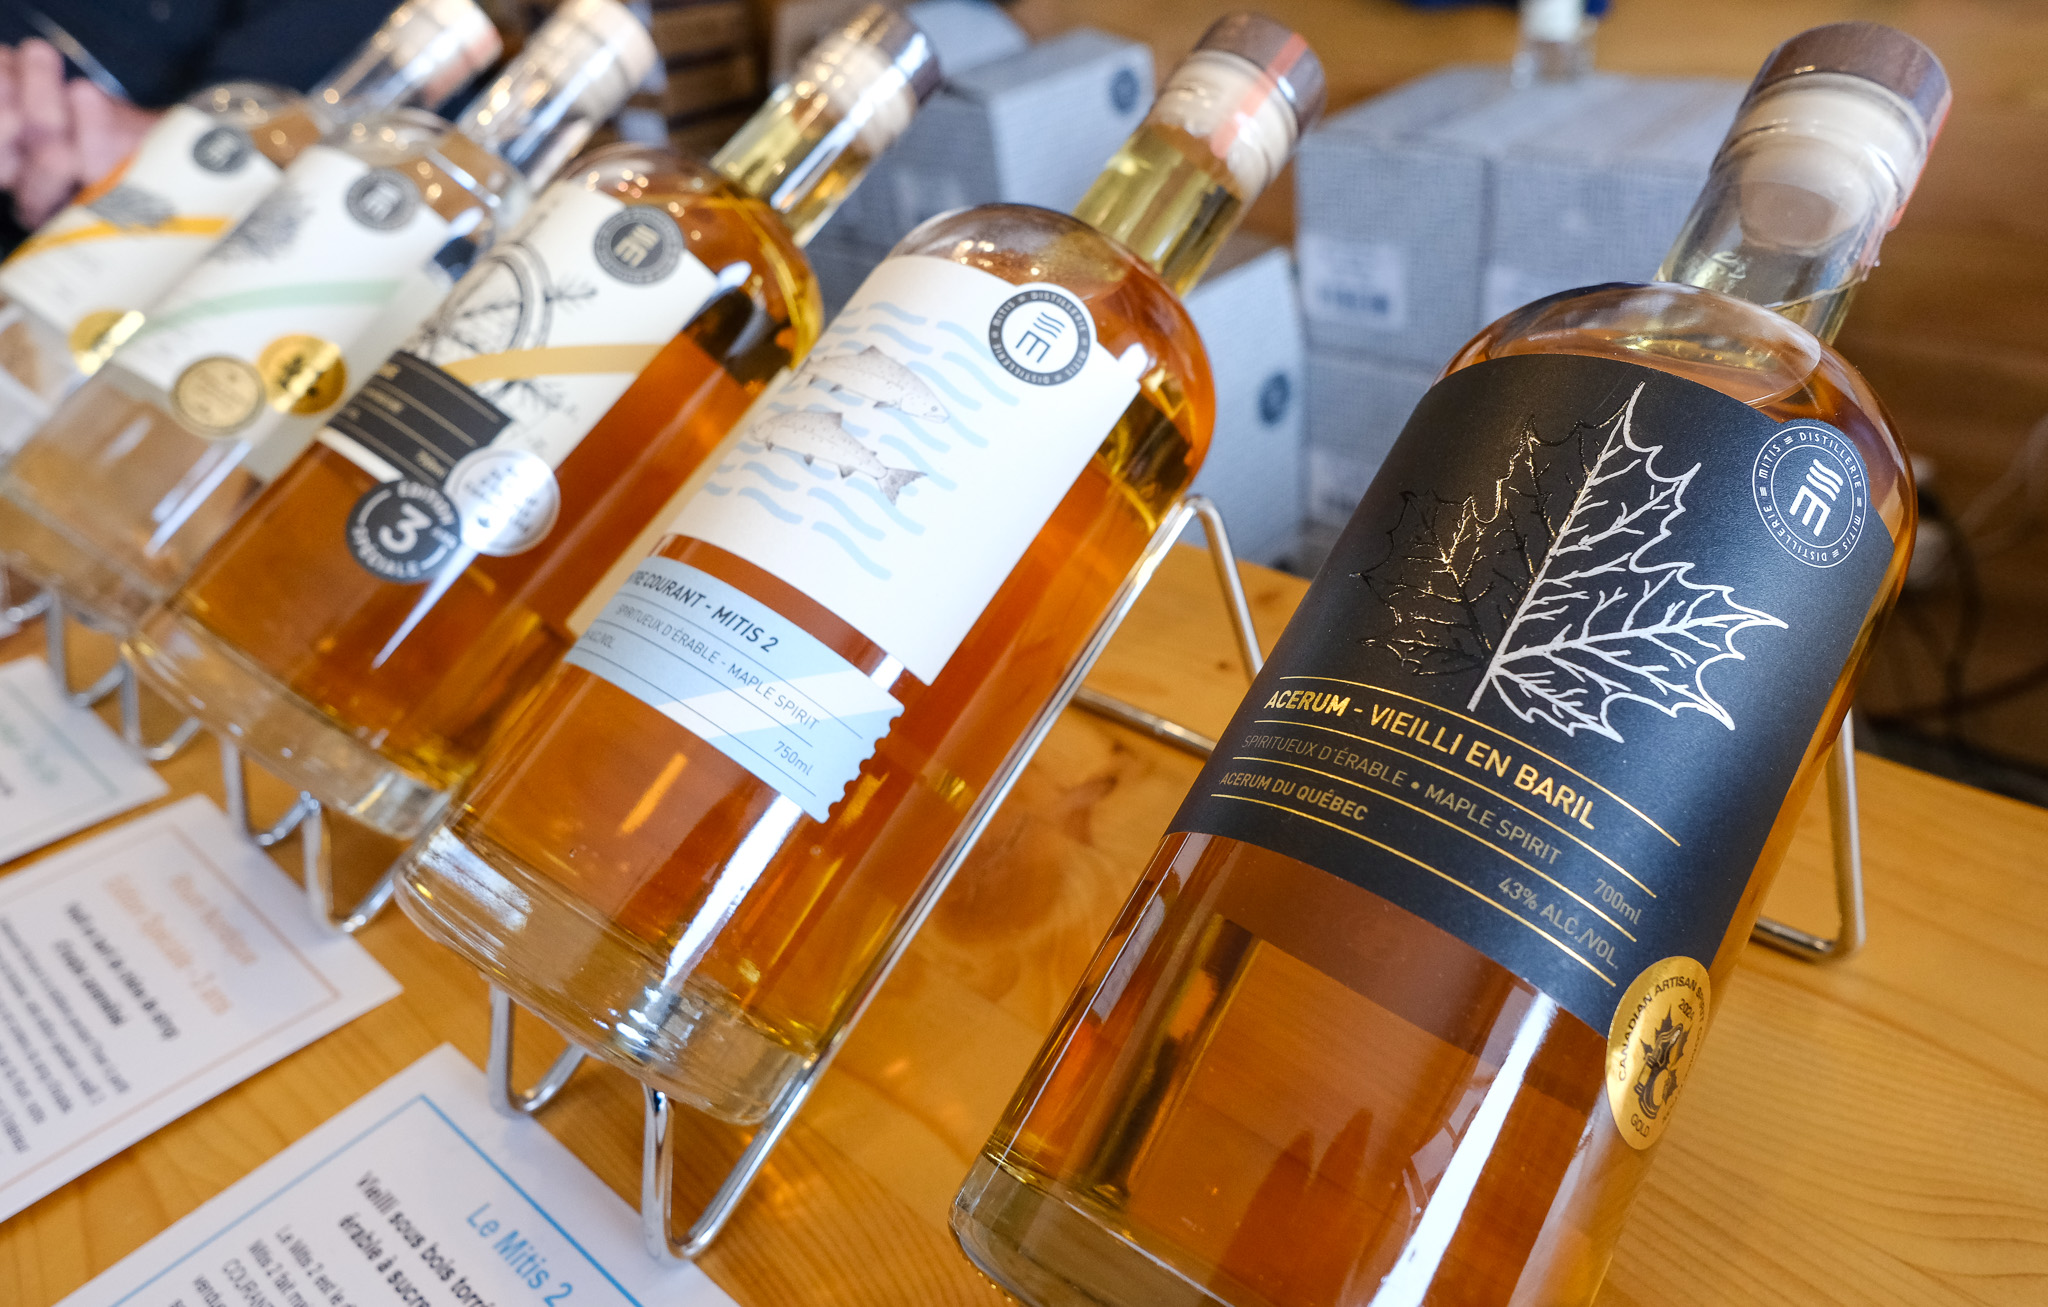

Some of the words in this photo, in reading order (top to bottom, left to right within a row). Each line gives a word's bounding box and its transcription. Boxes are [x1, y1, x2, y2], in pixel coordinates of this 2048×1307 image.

[1759, 444, 1781, 479] MITIS
[1799, 431, 1862, 488] DISTILLERIE
[378, 502, 433, 554] 3
[1764, 505, 1827, 562] DISTILLERIE
[1842, 515, 1861, 550] MITIS
[643, 573, 707, 608] COURANT
[711, 605, 765, 642] MITIS
[760, 637, 779, 653] 2
[661, 624, 721, 664] D'ÉRABLE
[727, 663, 776, 700] MAPLE
[774, 695, 820, 730] SPIRIT
[773, 740, 815, 777] 750ml
[1264, 690, 1351, 717] ACERUM
[1371, 704, 1463, 755] VIEILLI
[1465, 740, 1512, 777] EN
[1513, 763, 1594, 831] BARIL
[1219, 772, 1271, 791] ACERUM
[1271, 778, 1297, 797] DU
[1296, 788, 1369, 821] QUÉBEC
[1242, 735, 1315, 757] SPIRITUEUX
[1318, 747, 1408, 787] D'ÉRABLE
[1424, 784, 1497, 829] MAPLE
[1496, 819, 1563, 865] SPIRIT
[1498, 877, 1539, 910] 43%
[1539, 903, 1619, 970] ALC./VOL.
[1593, 877, 1642, 925] 700ml
[1618, 994, 1652, 1081] CANADIAN
[1654, 976, 1697, 995] ARTISAN
[1678, 998, 1695, 1021] 2024
[1630, 1113, 1650, 1138] GOLD
[388, 1212, 425, 1248] sous
[420, 1241, 455, 1282] bois
[466, 1201, 499, 1238] Le
[493, 1229, 550, 1289] Mitis
[544, 1282, 574, 1307] 2
